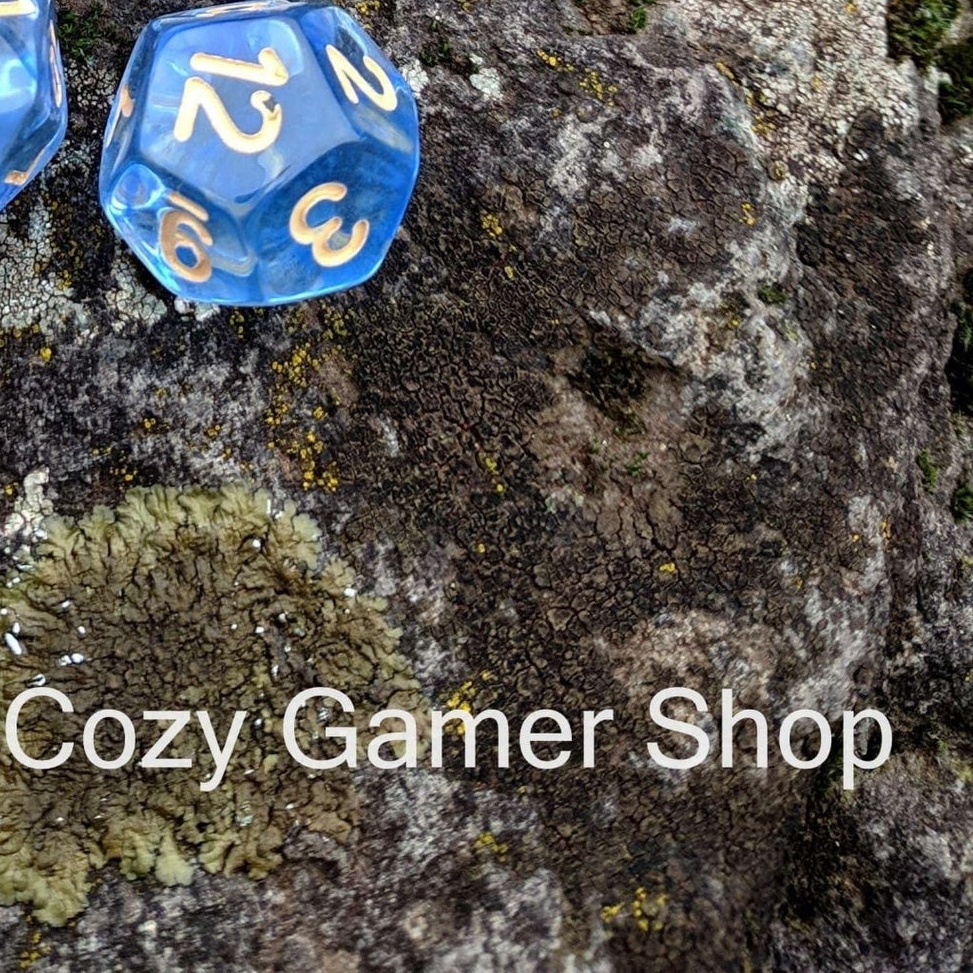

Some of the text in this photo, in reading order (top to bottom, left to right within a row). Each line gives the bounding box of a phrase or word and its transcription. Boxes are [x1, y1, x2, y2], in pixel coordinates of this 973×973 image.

[173, 47, 289, 154] 12
[326, 44, 397, 111] 2
[289, 182, 369, 267] 3
